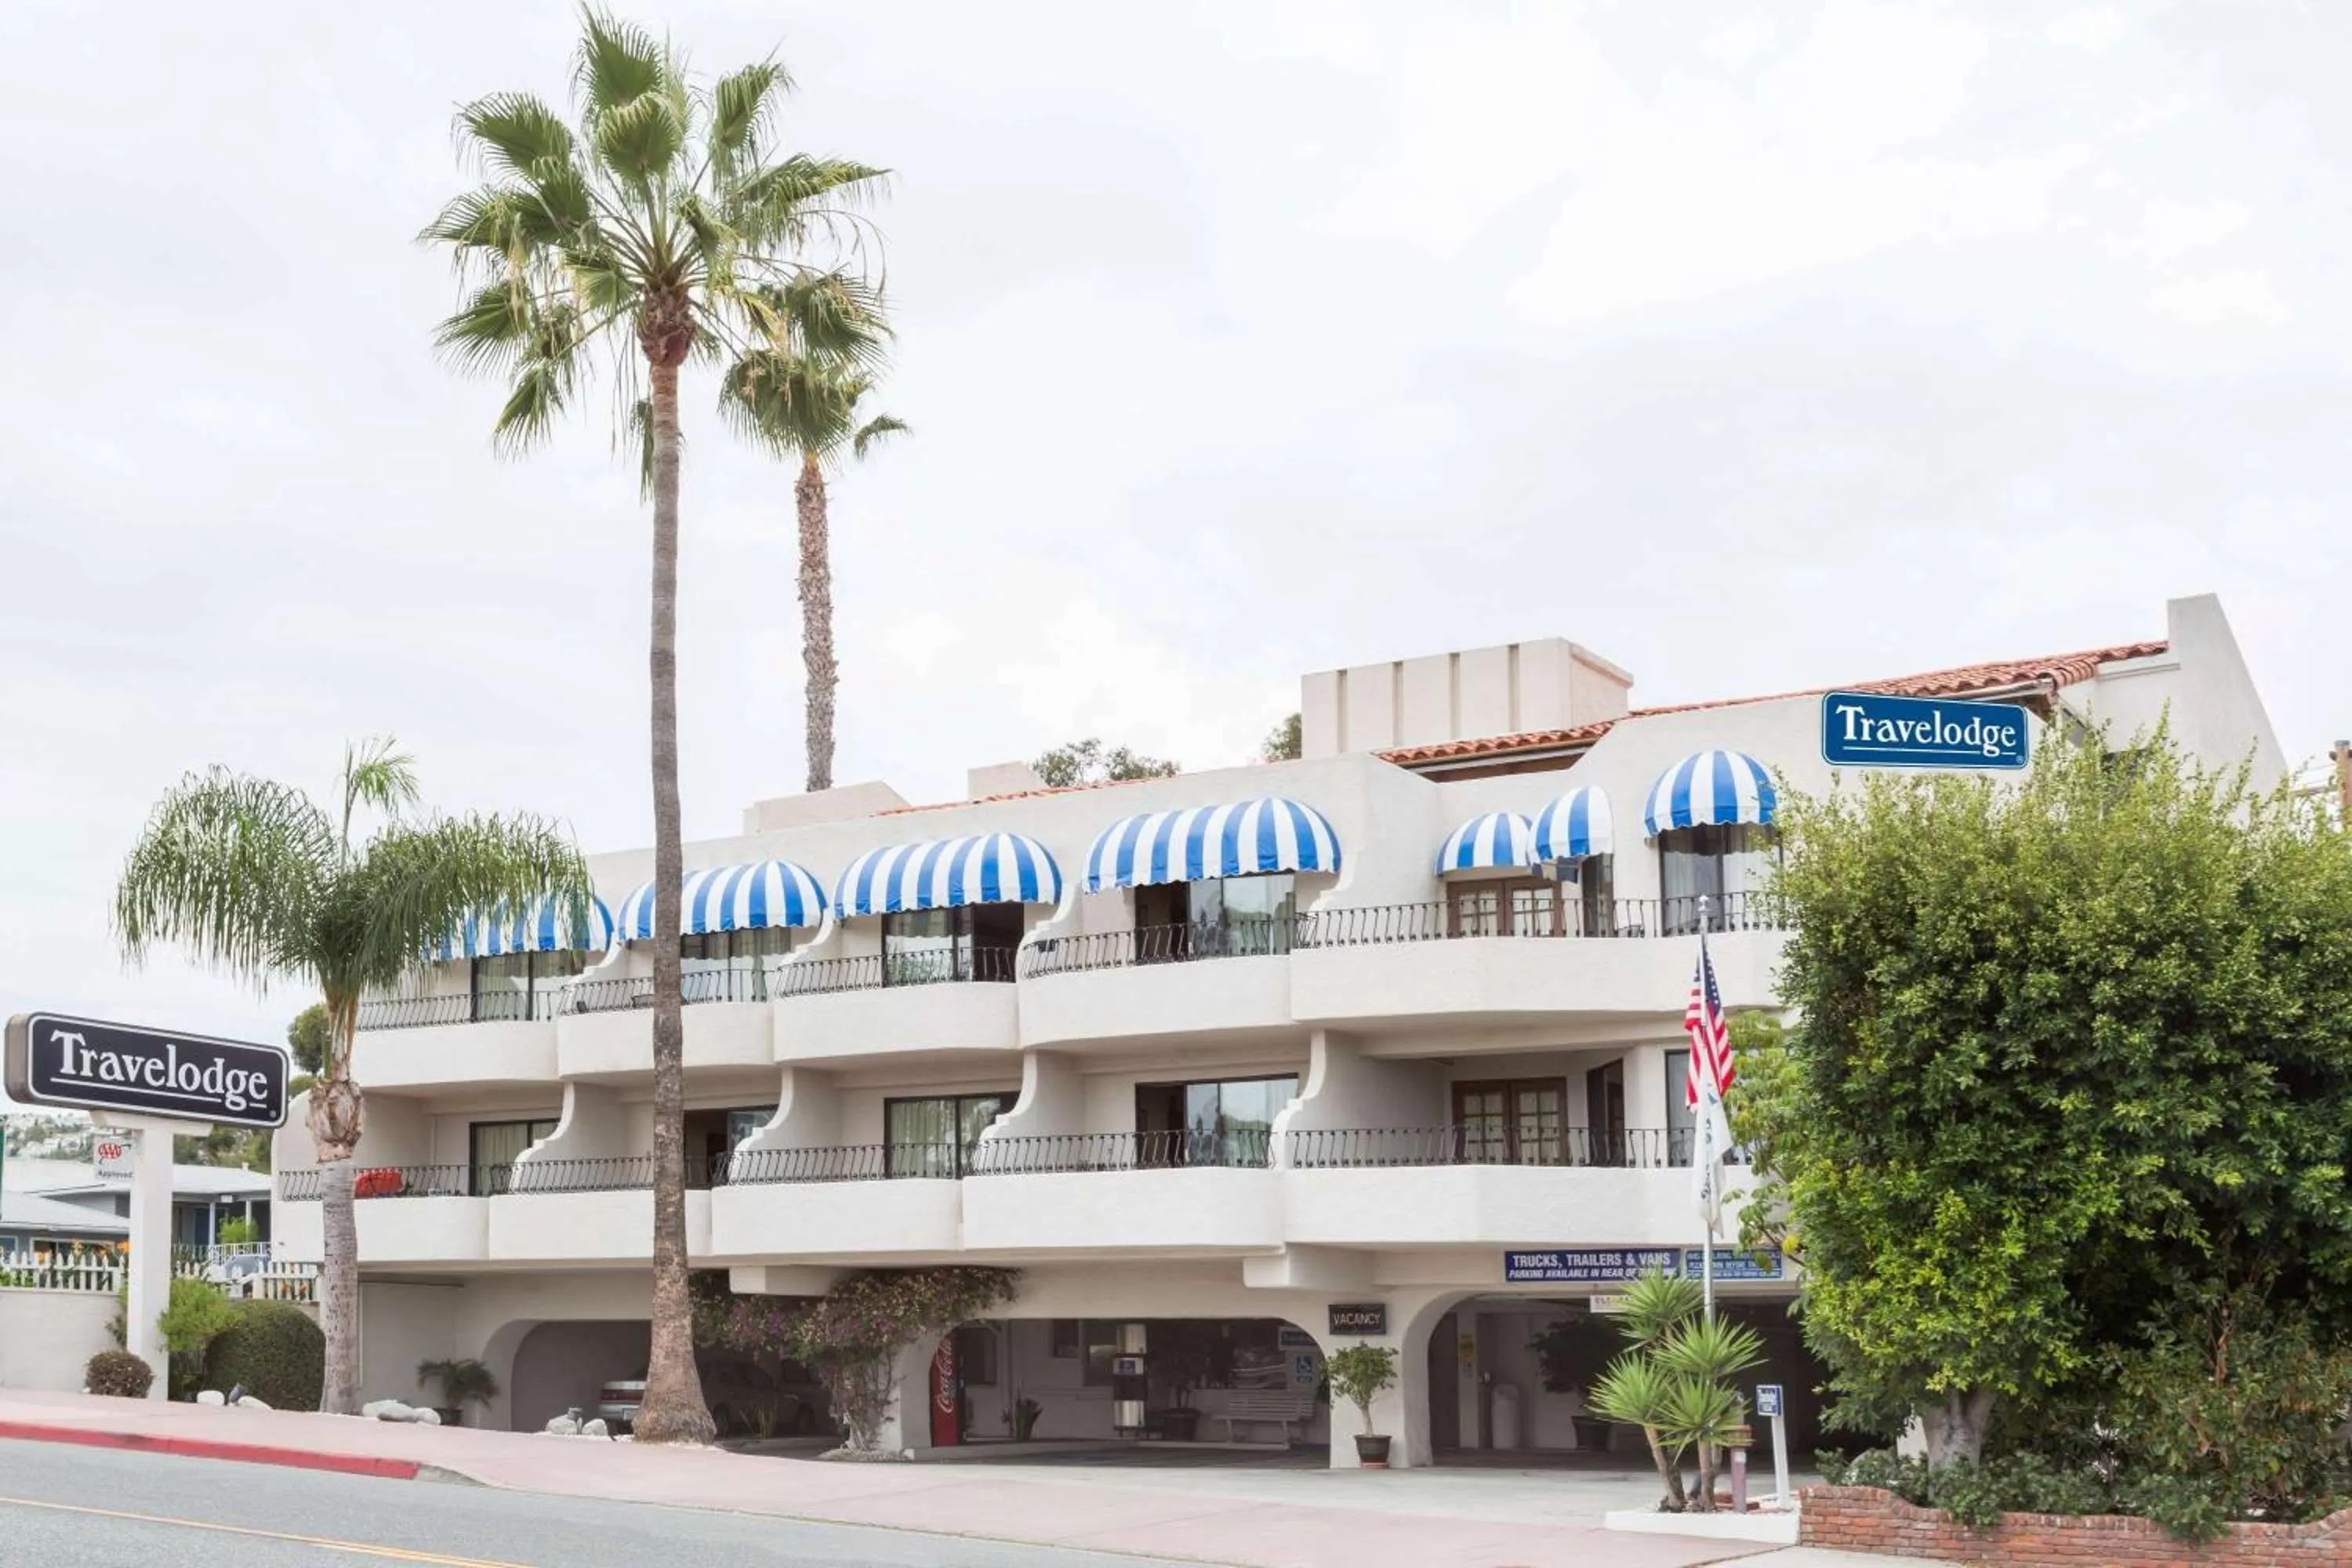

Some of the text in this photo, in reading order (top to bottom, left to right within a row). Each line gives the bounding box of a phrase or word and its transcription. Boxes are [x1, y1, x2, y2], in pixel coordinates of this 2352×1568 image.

[1835, 704, 2017, 757] Travelodge
[50, 1029, 268, 1112] Travelodge
[1512, 1254, 1563, 1269] TRUCKS,
[1566, 1253, 1621, 1267] TRAILERS
[1625, 1252, 1635, 1266] &
[1639, 1252, 1671, 1266] VANS
[1509, 1269, 1543, 1279] PARKING
[1545, 1269, 1588, 1279] AVAILABLE
[1589, 1269, 1600, 1278] IN
[1601, 1268, 1624, 1277] REAR
[1333, 1313, 1381, 1325] VACANCY
